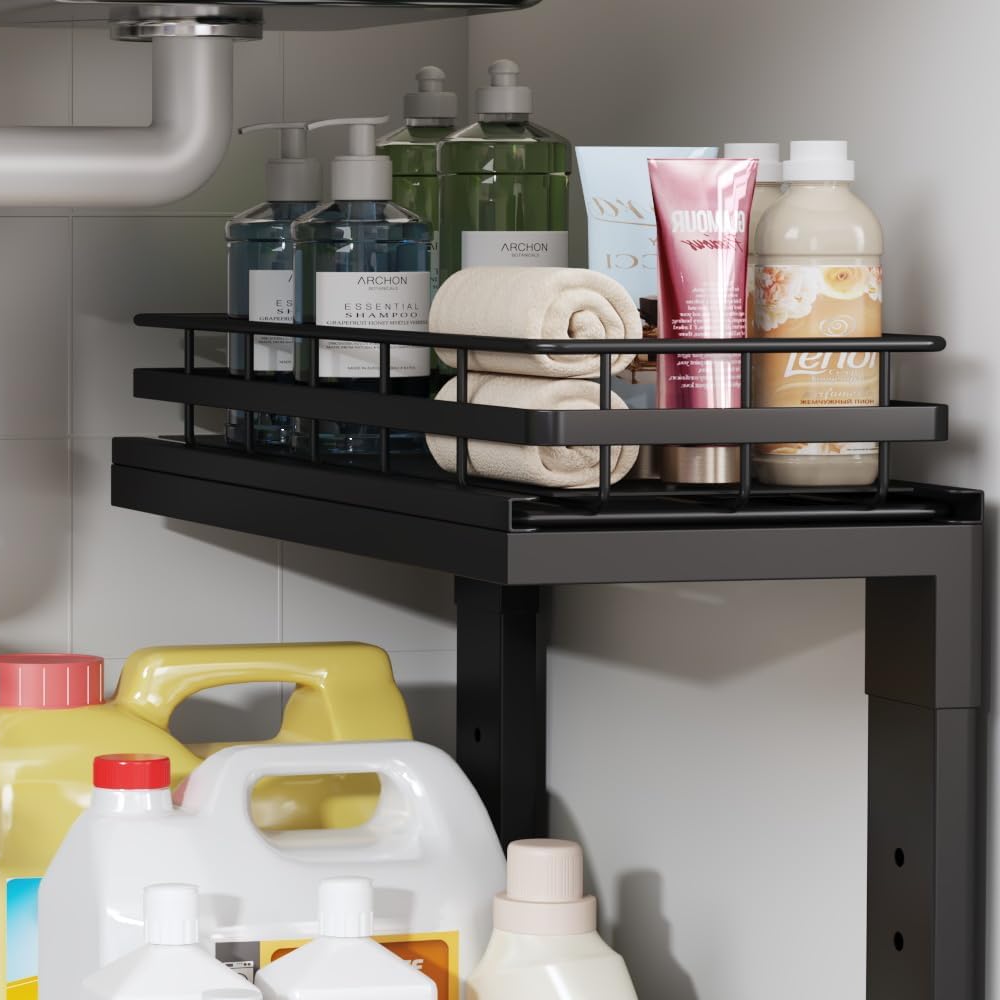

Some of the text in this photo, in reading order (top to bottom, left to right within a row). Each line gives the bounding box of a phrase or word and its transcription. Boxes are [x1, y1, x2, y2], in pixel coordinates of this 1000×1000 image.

[501, 242, 548, 252] ARCHON
[357, 275, 408, 286] ARCHON
[344, 302, 420, 311] ESSENTIAL
[345, 311, 418, 319] SHAMPOO
